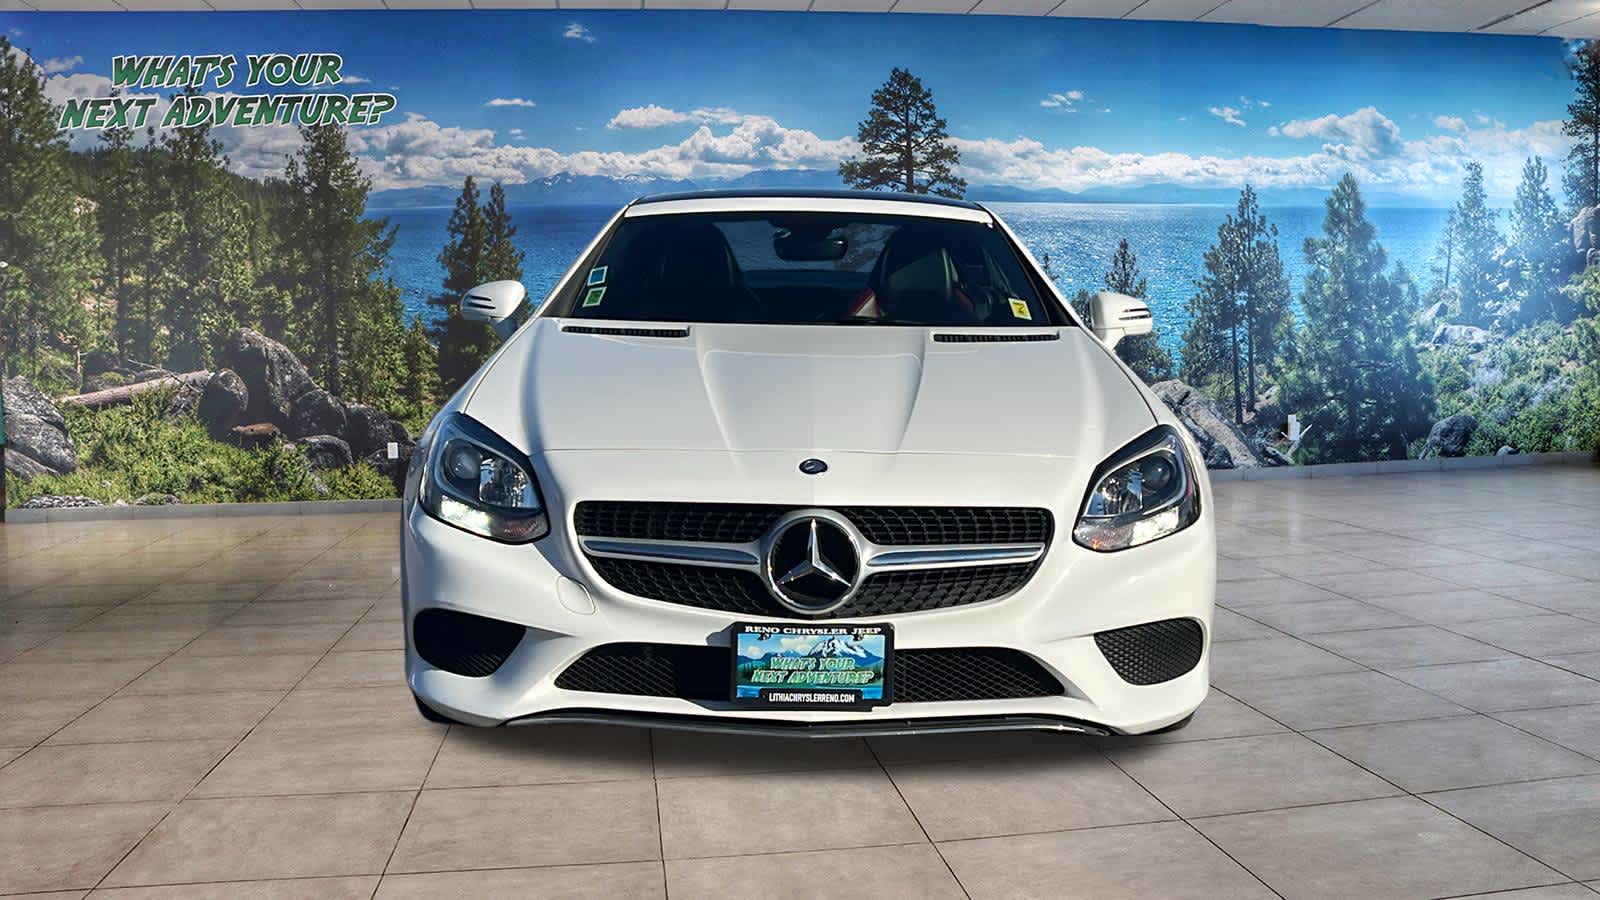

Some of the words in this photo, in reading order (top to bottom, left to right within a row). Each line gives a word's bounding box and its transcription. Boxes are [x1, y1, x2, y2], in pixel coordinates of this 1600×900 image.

[112, 54, 237, 88] WHAT'S
[246, 53, 343, 87] YOUR
[58, 96, 160, 131] NEXT
[160, 93, 396, 128] ADVENTURE?
[745, 626, 780, 634] RENO
[783, 627, 848, 635] CHRYSLER
[851, 627, 882, 635] JEEP
[770, 657, 816, 670] WHAT'S
[819, 657, 855, 670] YOUR
[751, 669, 788, 684] NEXT
[787, 670, 875, 684] ADVENTURE?
[769, 692, 855, 703] LITHIACHRYSLERRENO.COM
